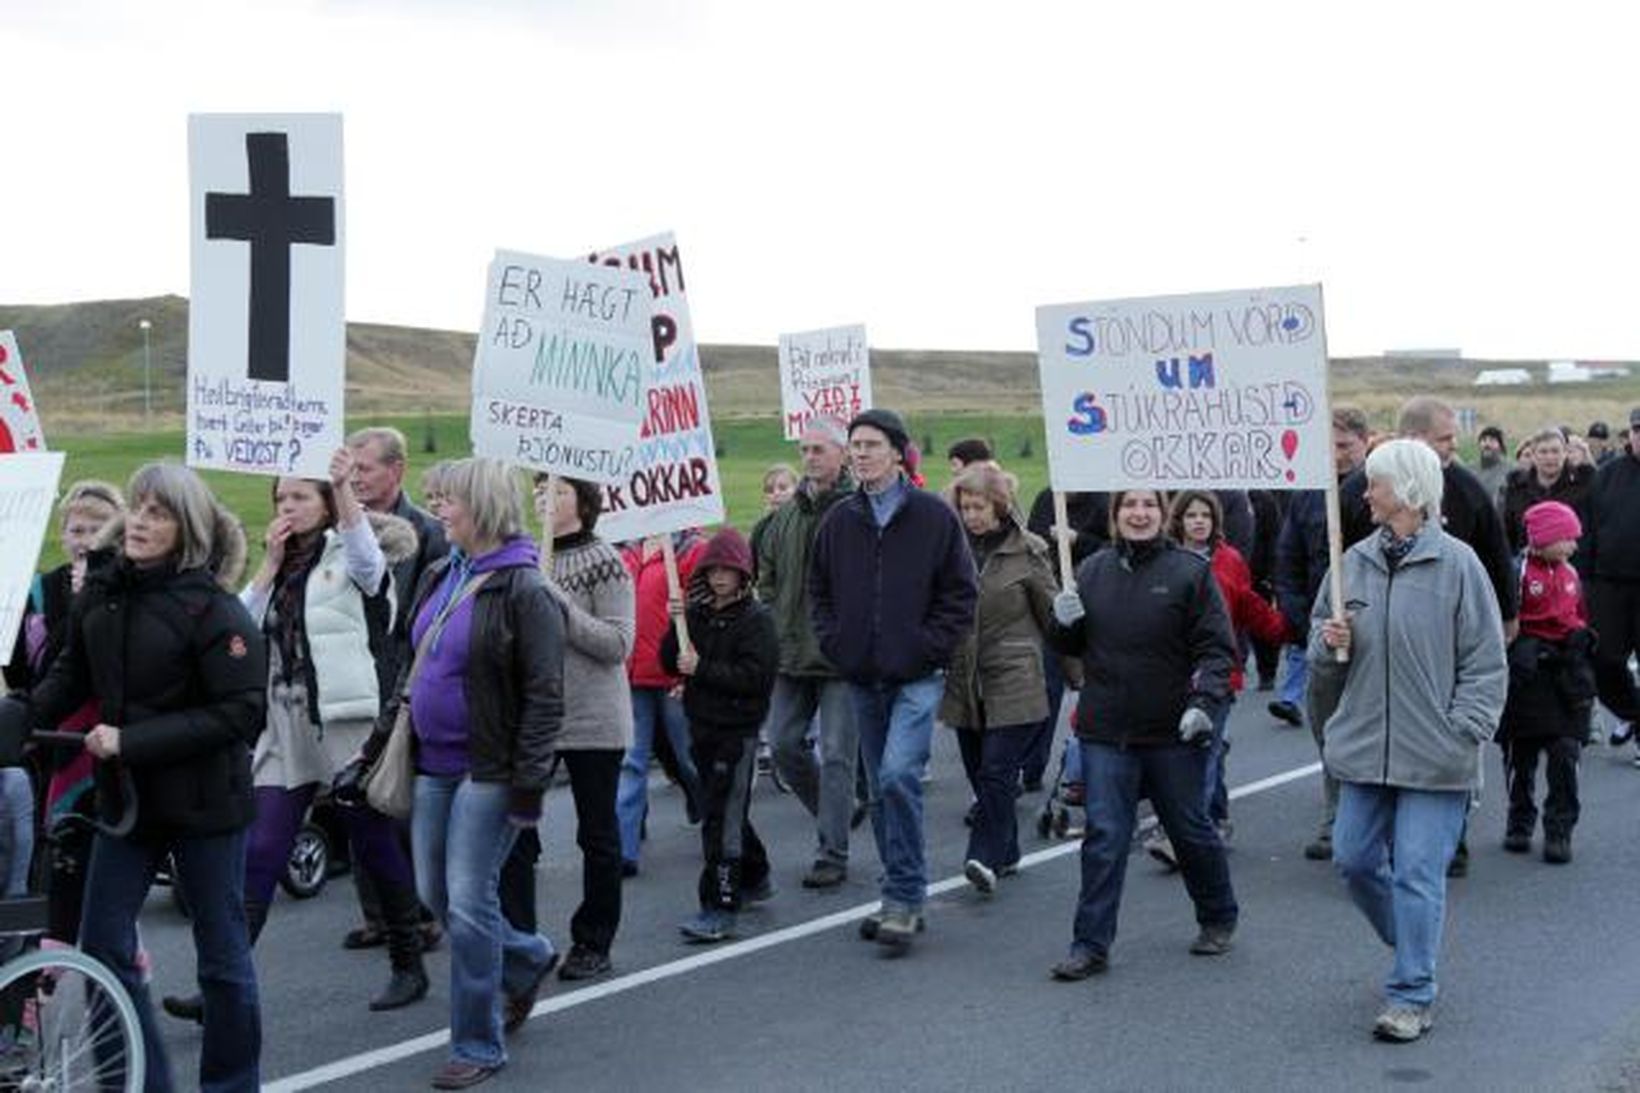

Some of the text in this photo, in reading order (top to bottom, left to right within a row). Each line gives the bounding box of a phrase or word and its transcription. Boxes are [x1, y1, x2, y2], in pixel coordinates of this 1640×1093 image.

[500, 266, 637, 322] ER HÆGT
[488, 402, 563, 433] SKERTA
[1121, 429, 1299, 483] OKKAR!
[630, 458, 713, 507] OKKAR
